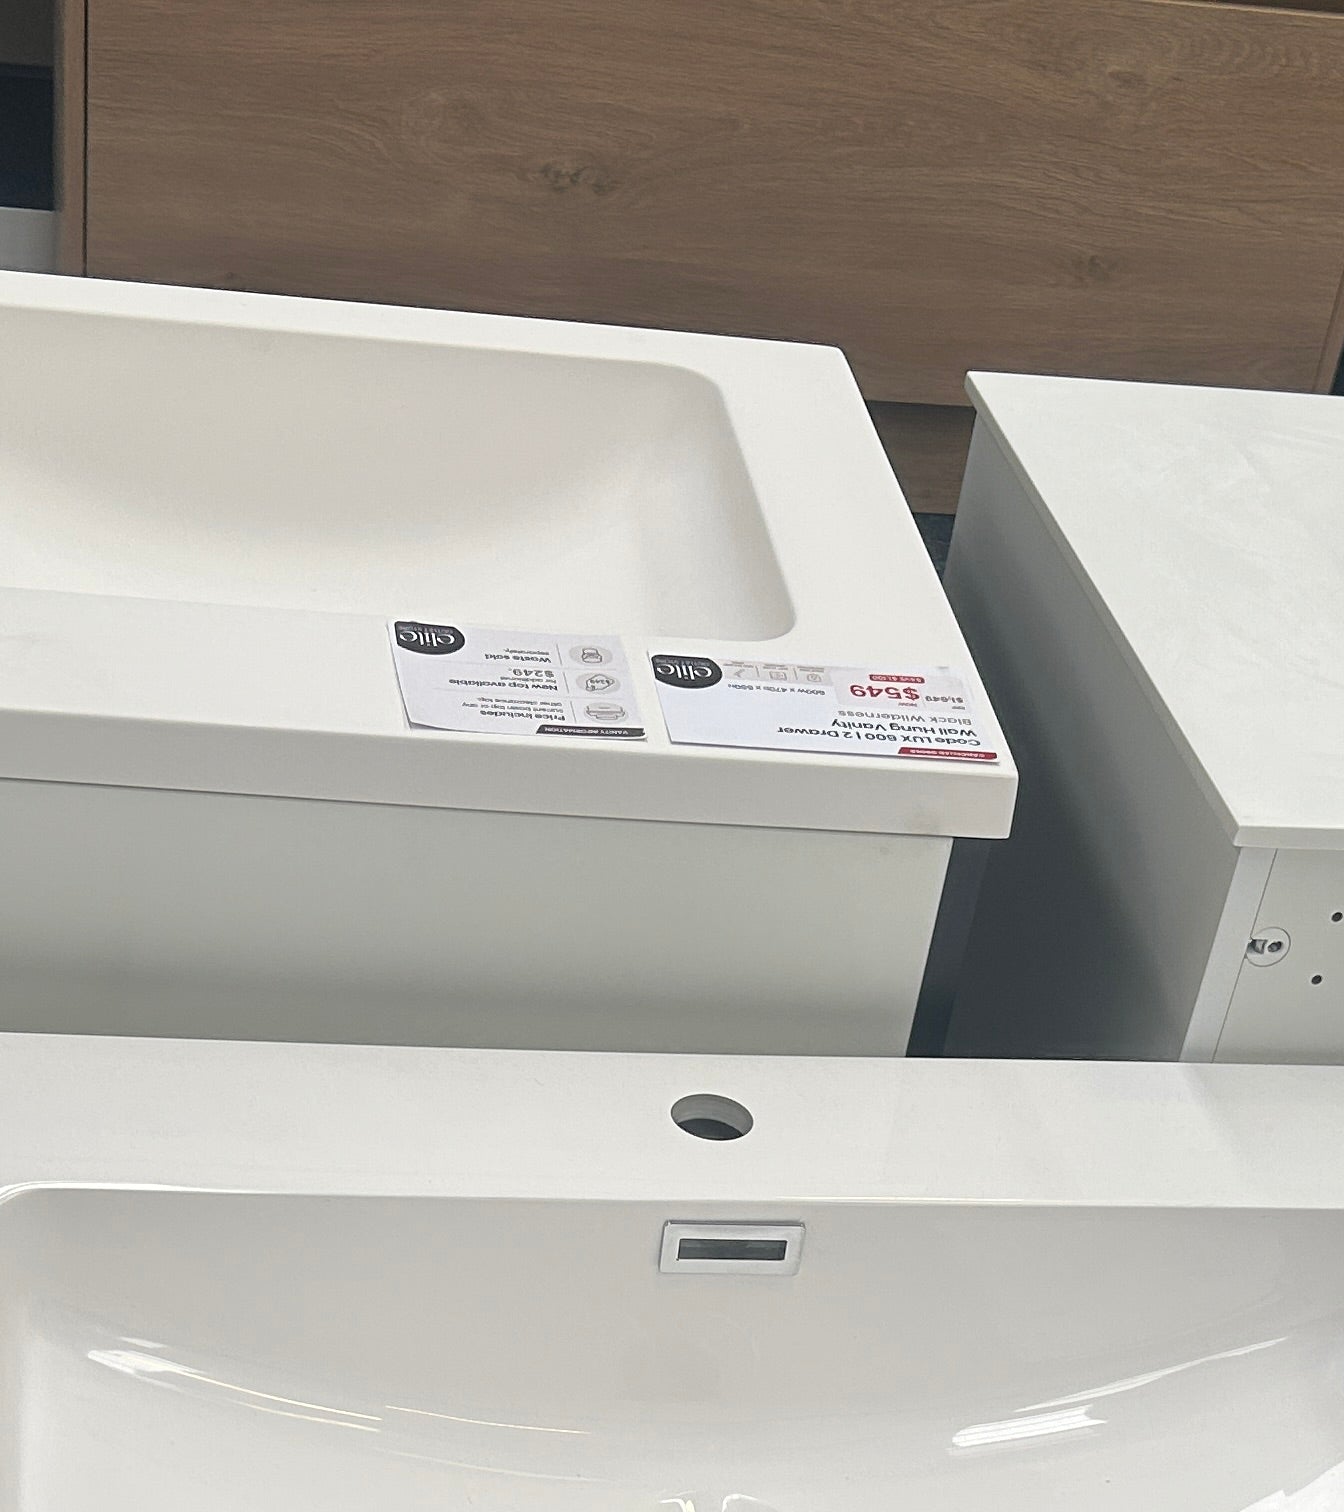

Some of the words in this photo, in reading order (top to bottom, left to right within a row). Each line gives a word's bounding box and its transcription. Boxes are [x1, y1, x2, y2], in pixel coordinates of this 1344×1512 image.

[512, 655, 551, 664] Waste
[449, 680, 506, 688] available
[850, 685, 920, 700] $549
[480, 710, 533, 720] includes
[535, 713, 566, 721] Price
[837, 711, 926, 722] Wilderness
[831, 719, 888, 731] Vanity
[930, 717, 972, 726] Black
[777, 727, 840, 738] Drawer
[889, 723, 934, 734] Hung
[936, 729, 977, 737] Wall
[843, 731, 853, 739] 2
[865, 733, 897, 742] 600
[901, 735, 933, 743] LUX
[935, 738, 981, 746] Code
